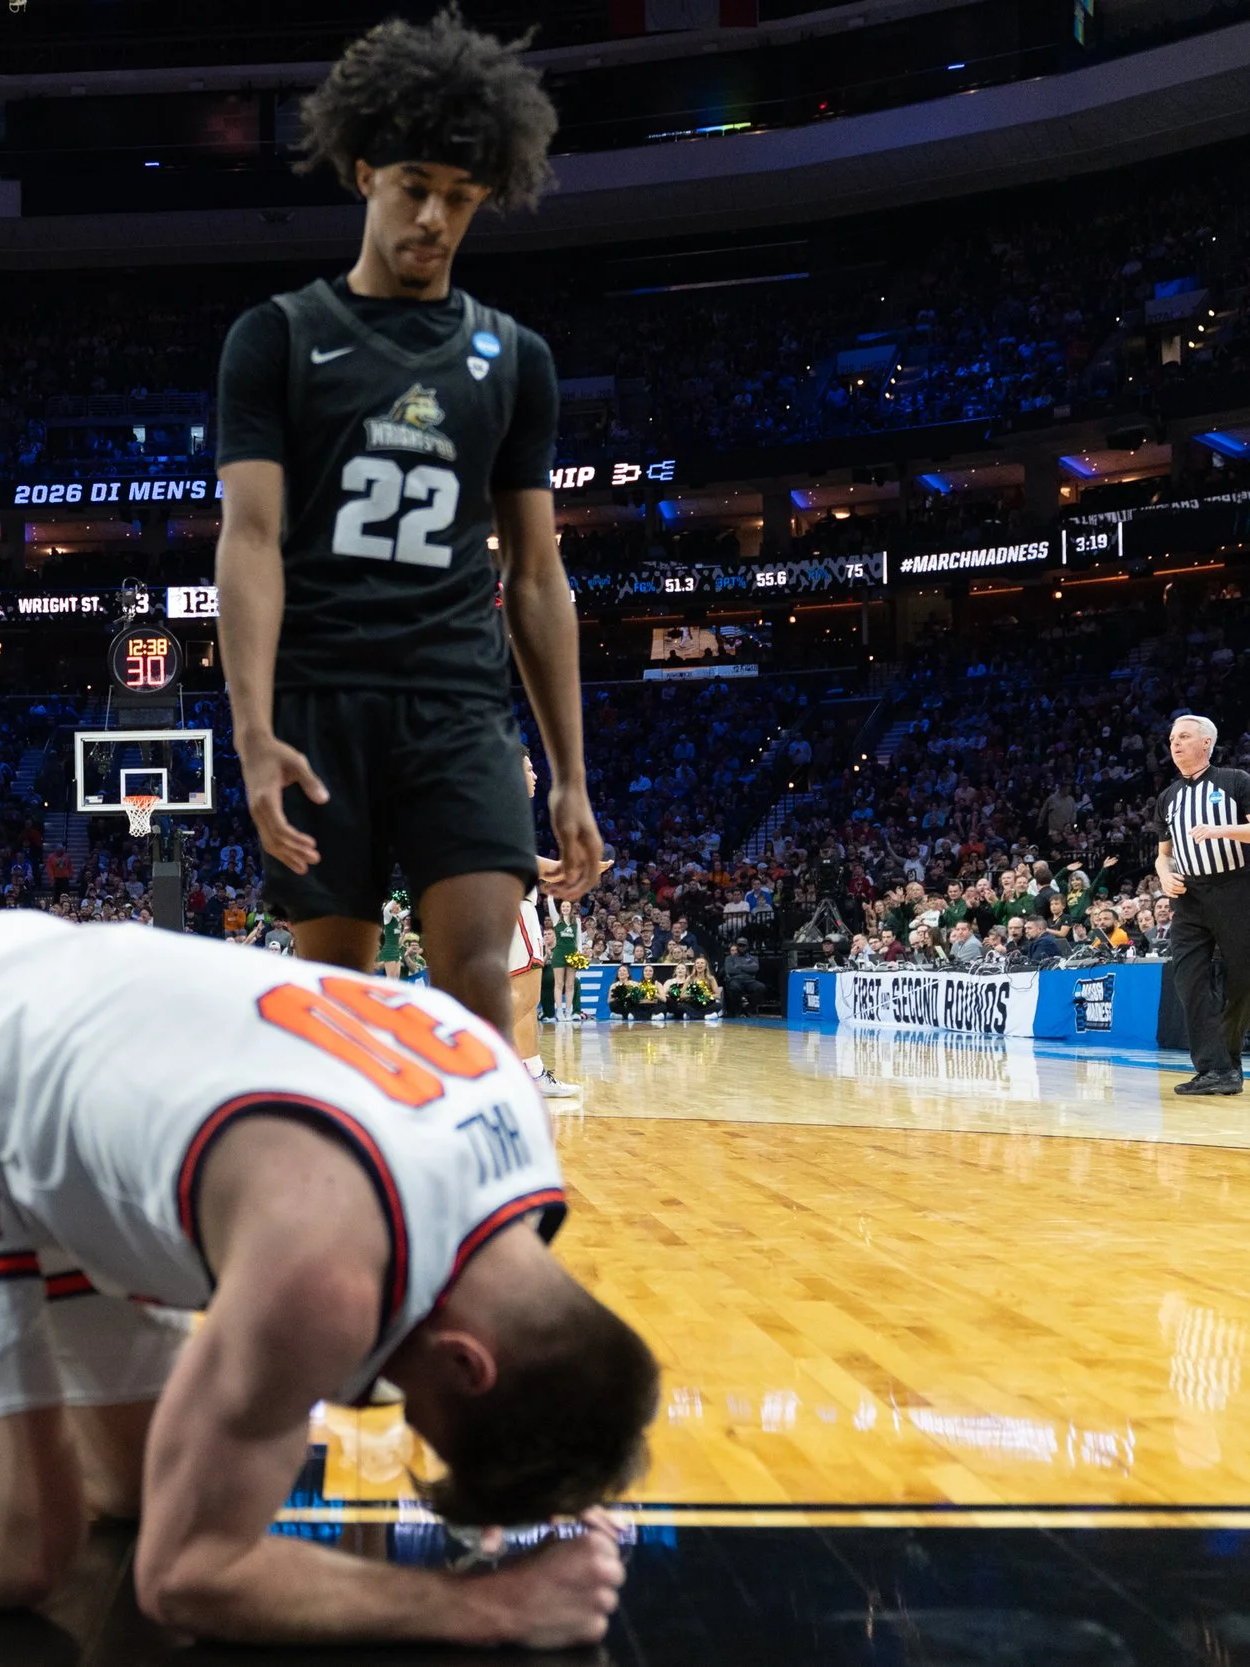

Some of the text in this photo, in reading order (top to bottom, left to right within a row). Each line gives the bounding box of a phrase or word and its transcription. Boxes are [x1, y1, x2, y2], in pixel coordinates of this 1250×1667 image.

[14, 484, 83, 504] 2026
[90, 482, 121, 502] DI
[128, 480, 207, 501] MEN'S
[332, 456, 460, 569] 22
[1075, 533, 1108, 552] 3:19
[900, 541, 1050, 573] #MARCHMADNESS
[665, 578, 694, 592] 51.3
[756, 571, 787, 587] 55.6
[846, 564, 863, 578] 75
[18, 597, 78, 614] WRIGHT
[81, 597, 104, 612] ST.
[183, 591, 216, 614] 12:
[128, 638, 168, 656] 12:38
[126, 656, 165, 686] 30
[853, 977, 881, 1021] FIRST
[892, 977, 939, 1027] SECOND
[944, 981, 1010, 1034] ROUNDS
[256, 976, 498, 1109] 30
